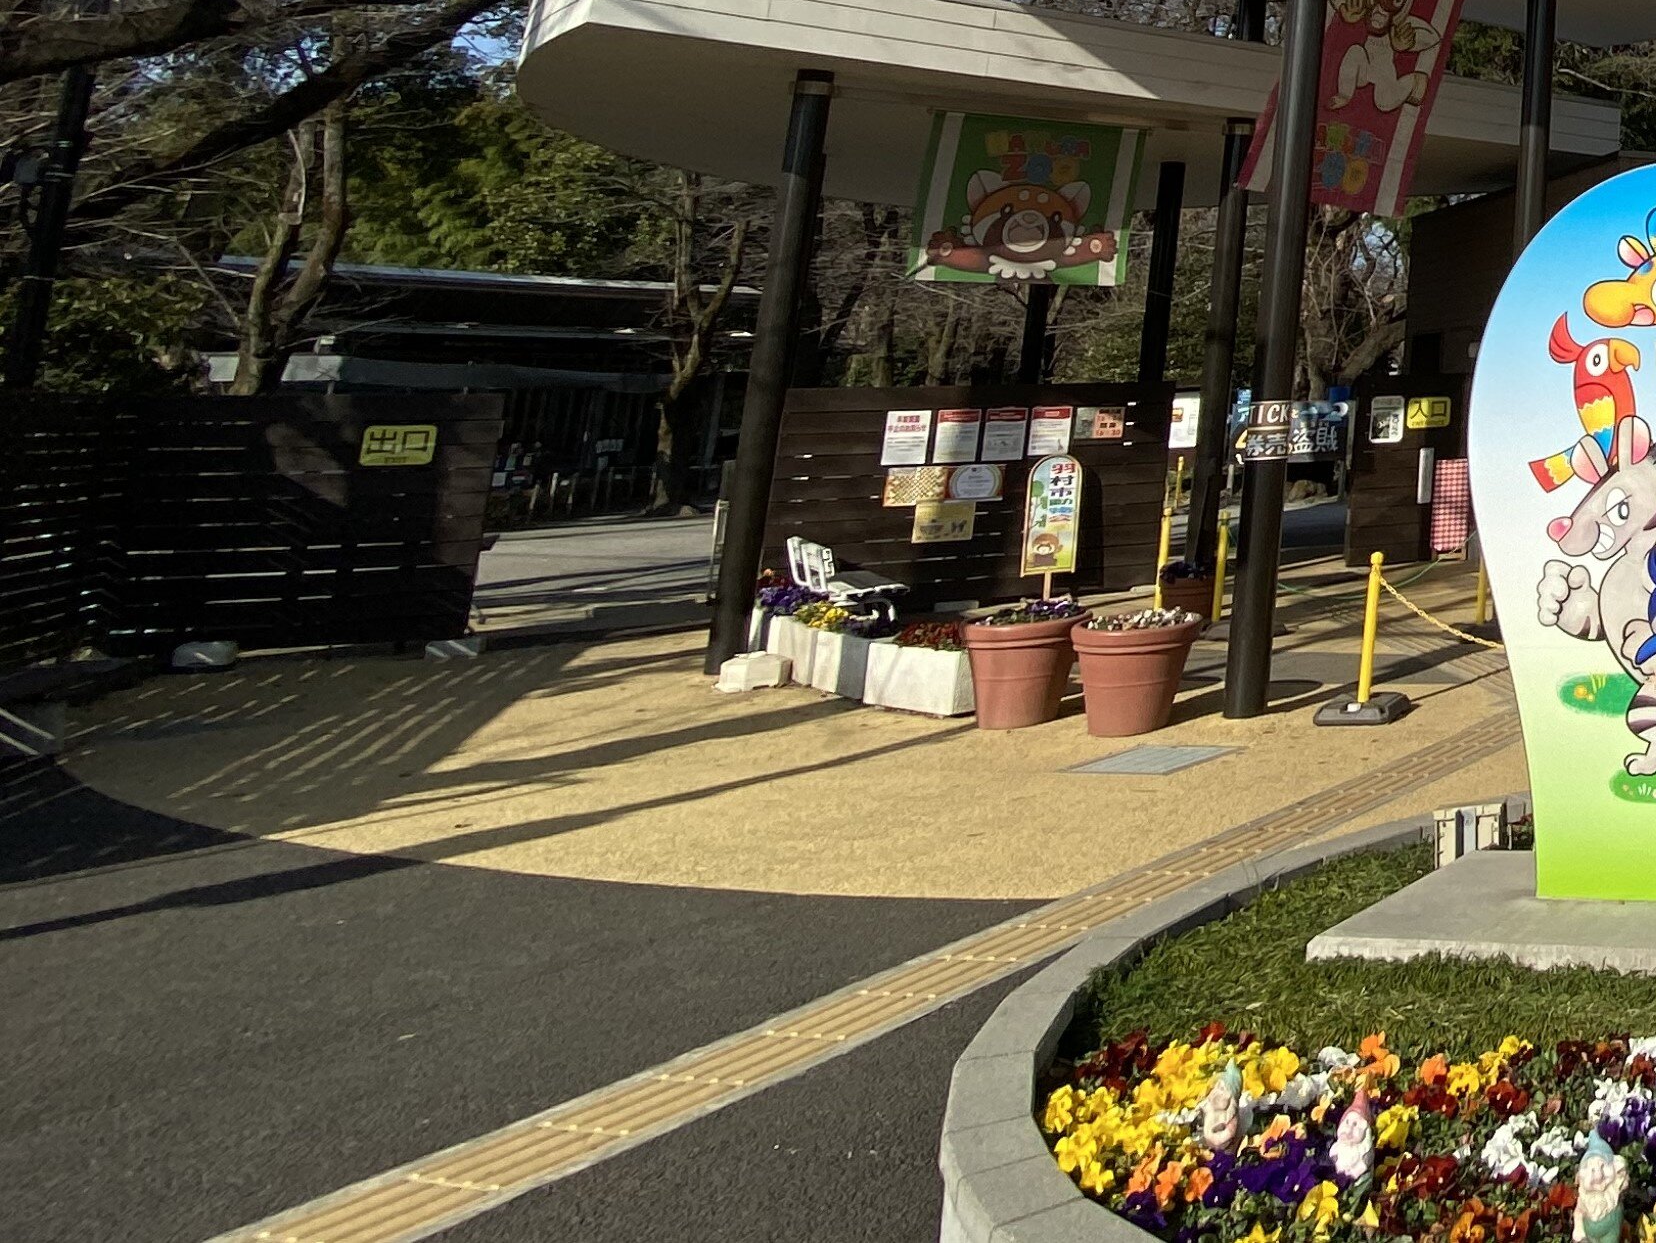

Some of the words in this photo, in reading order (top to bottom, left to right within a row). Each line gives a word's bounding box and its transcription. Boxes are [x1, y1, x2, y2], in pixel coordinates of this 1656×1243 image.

[985, 130, 1090, 158] HAMURA
[1314, 124, 1386, 164] AMURA
[1001, 153, 1077, 186] ZOO
[1410, 400, 1447, 419] 入口
[366, 429, 430, 454] 出口
